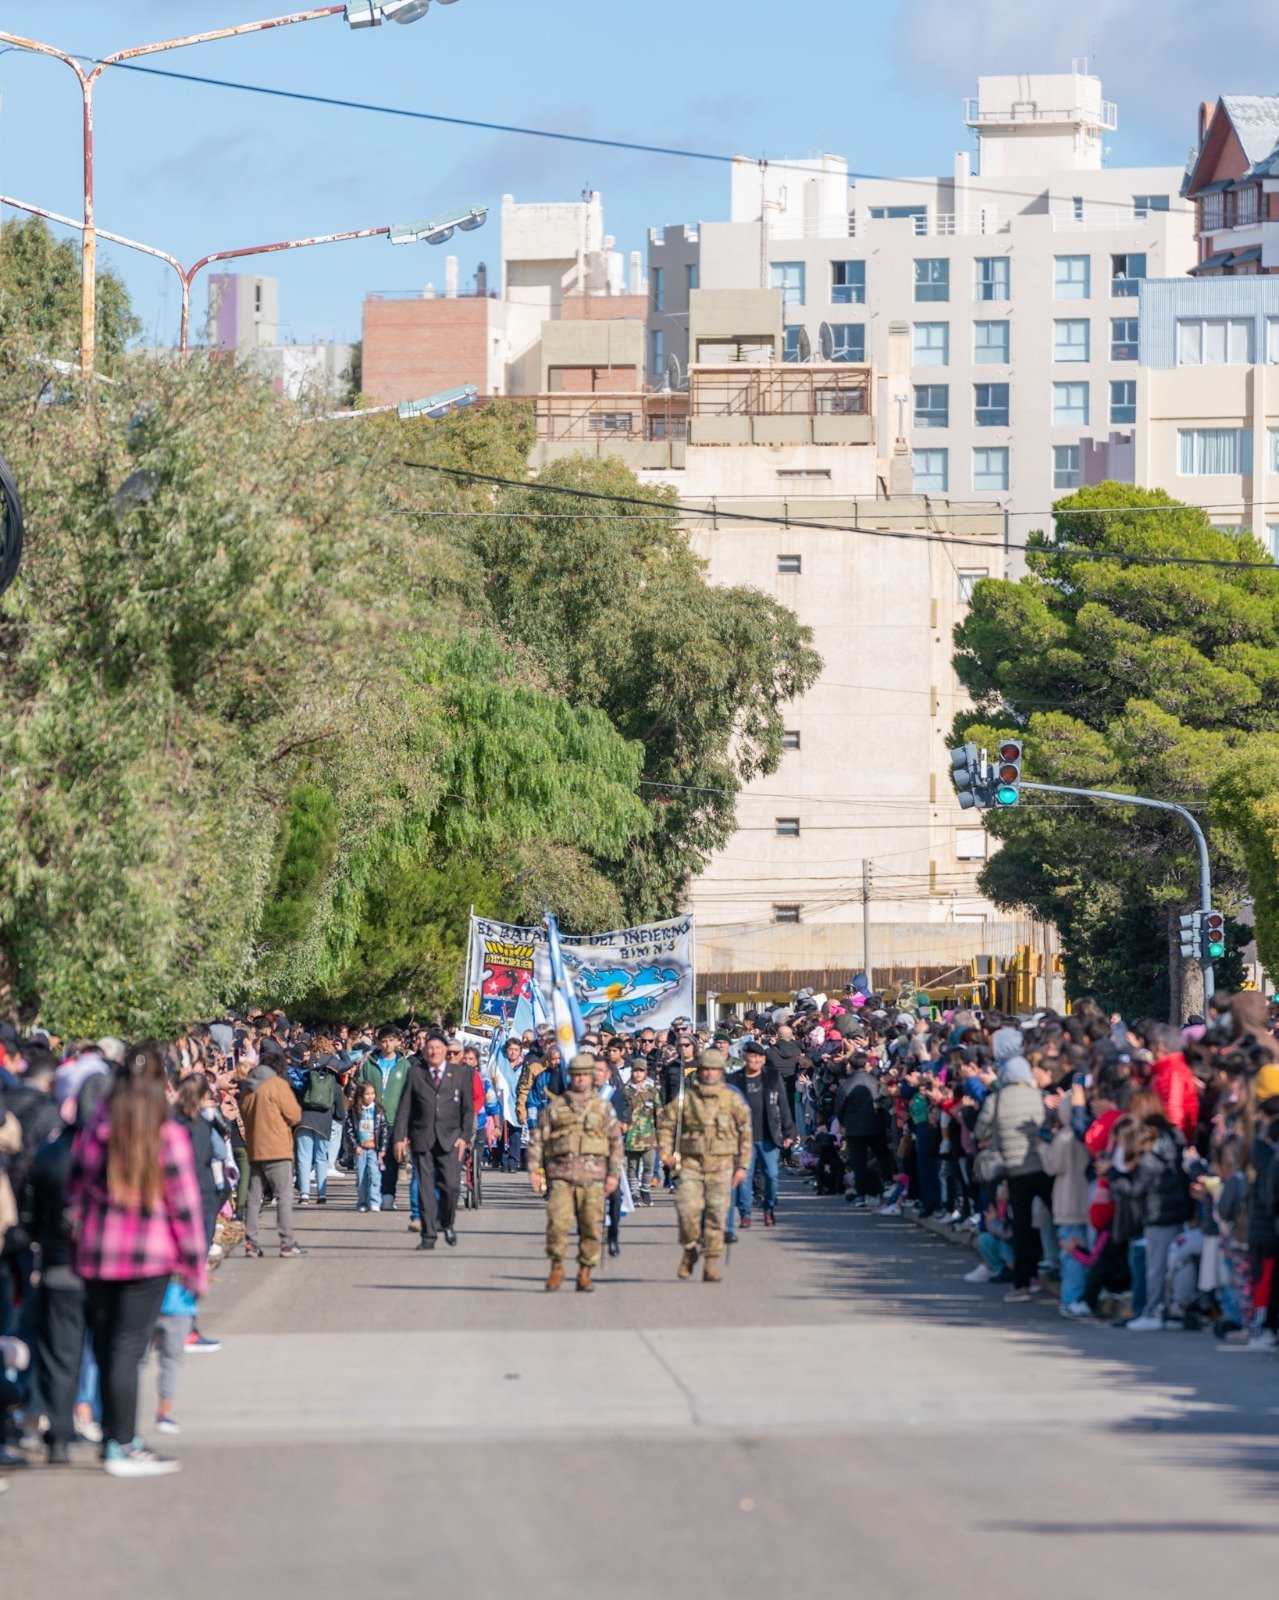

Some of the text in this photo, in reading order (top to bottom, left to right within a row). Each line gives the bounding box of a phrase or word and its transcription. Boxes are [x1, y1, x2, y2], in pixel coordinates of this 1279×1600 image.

[477, 921, 494, 937] EL
[589, 933, 616, 947] DEL
[622, 920, 690, 945] INFIERNO
